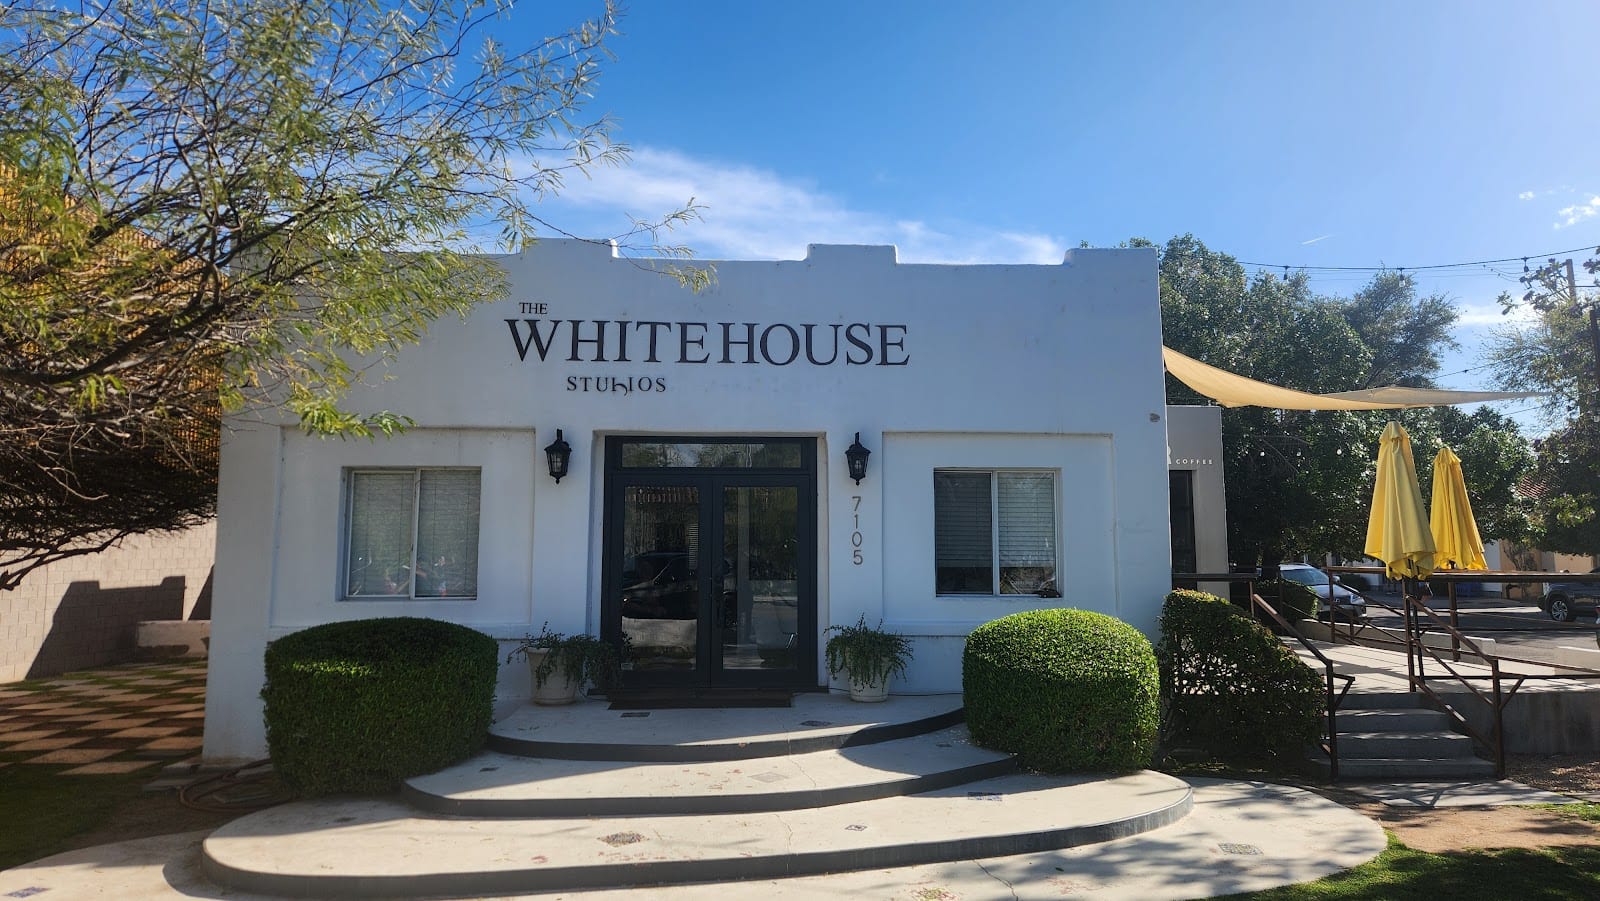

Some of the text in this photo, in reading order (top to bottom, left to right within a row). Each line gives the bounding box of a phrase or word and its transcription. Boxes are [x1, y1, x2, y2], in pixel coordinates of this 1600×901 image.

[519, 302, 548, 315] THE
[504, 318, 910, 366] WHITEHOUSE
[851, 496, 863, 566] 7105
